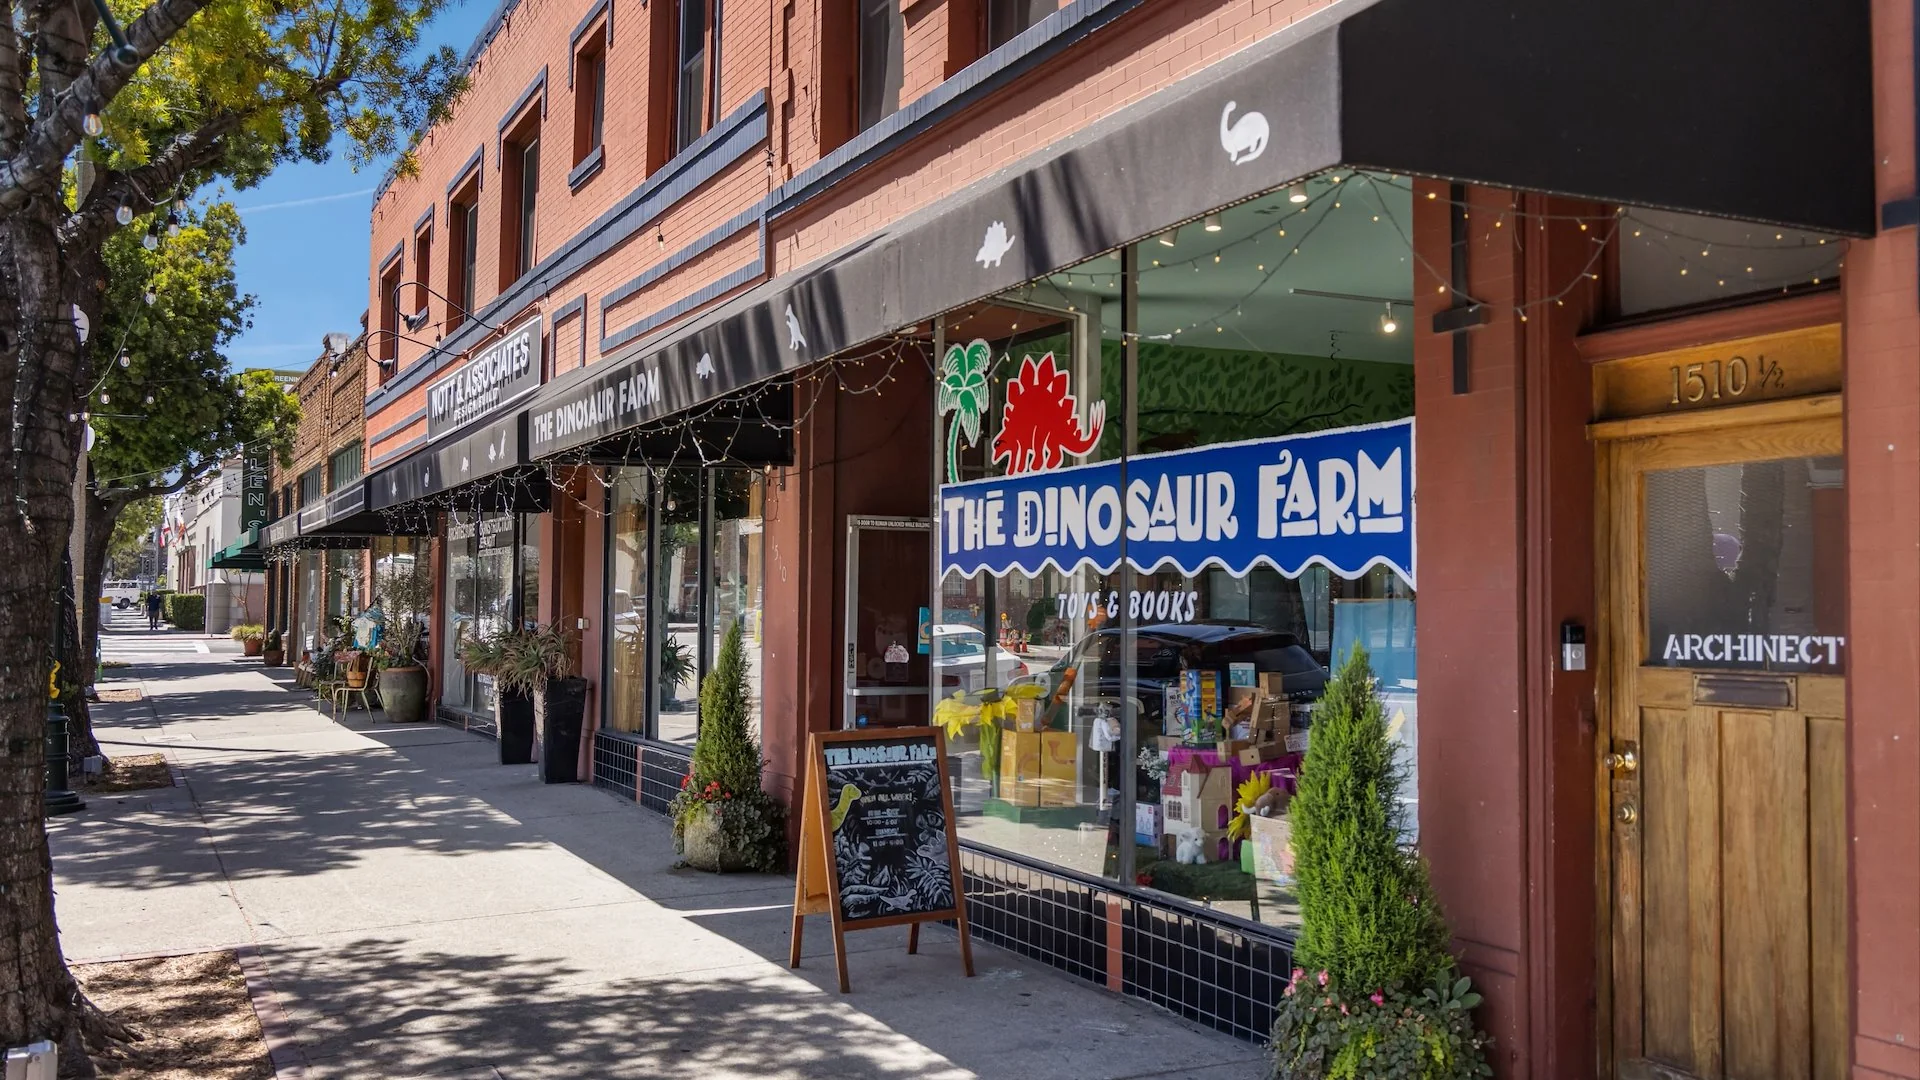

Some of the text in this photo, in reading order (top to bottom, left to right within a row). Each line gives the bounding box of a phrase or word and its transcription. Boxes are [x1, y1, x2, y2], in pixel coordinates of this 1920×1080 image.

[432, 332, 530, 418] NOTT & ASSOCIATES
[534, 366, 660, 445] THE DINOSAUR FARM
[1670, 356, 1748, 404] 1510
[943, 447, 1404, 555] THE DINOSAUR FARM
[1058, 590, 1198, 624] TOYS & BOOKS
[1663, 634, 1845, 665] ARCHINECT
